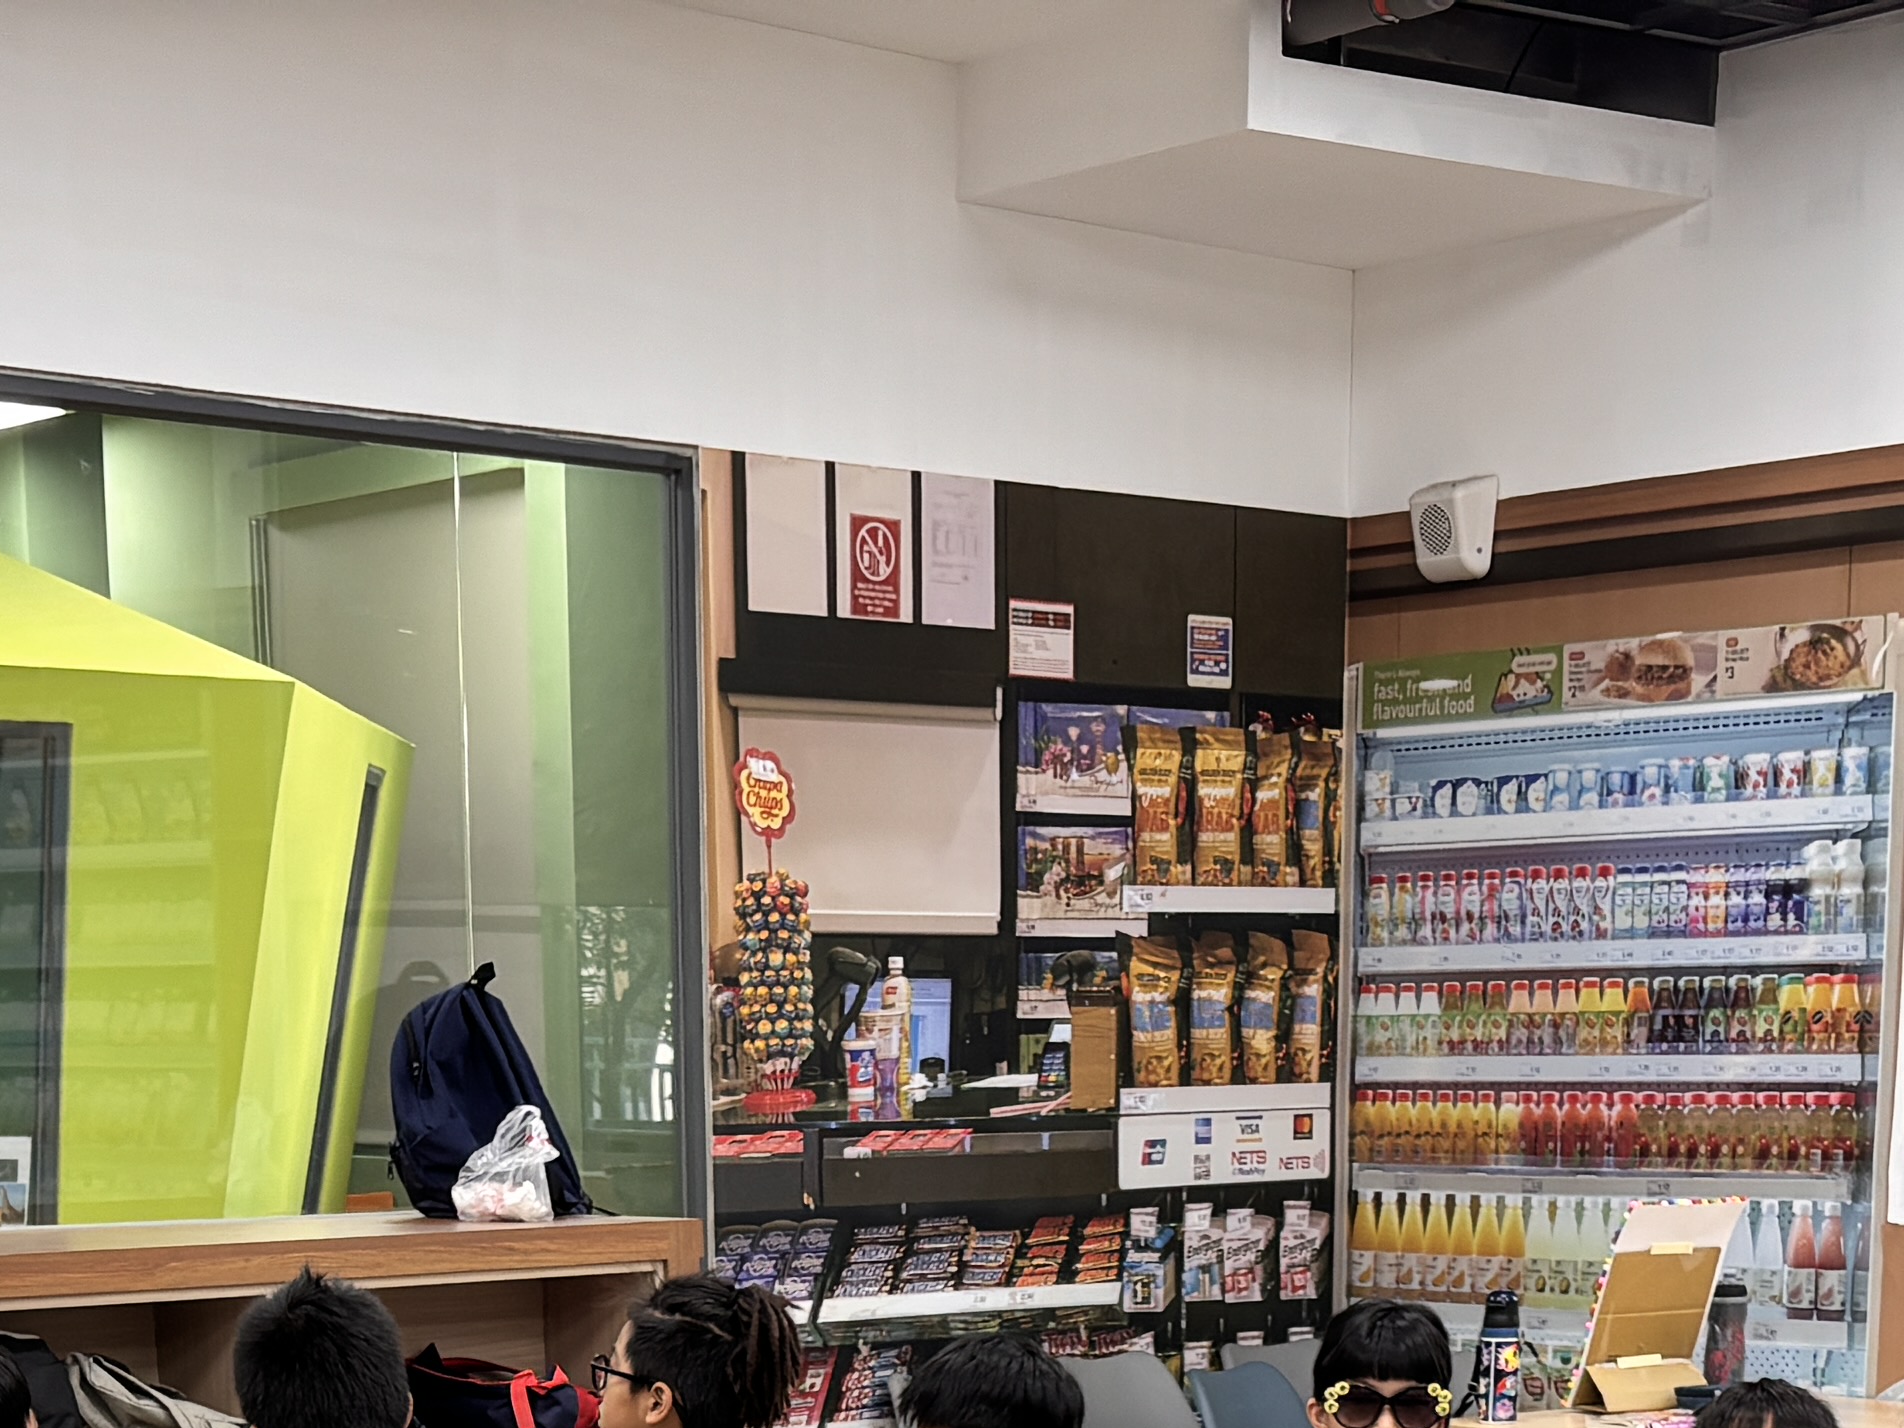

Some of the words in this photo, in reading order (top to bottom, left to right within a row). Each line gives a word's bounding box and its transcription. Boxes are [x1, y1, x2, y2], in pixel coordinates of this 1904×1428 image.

[1374, 683, 1403, 701] fast,
[1373, 698, 1440, 721] flavourful
[1444, 696, 1475, 714] food
[746, 790, 784, 811] Chups
[1240, 1123, 1260, 1135] VISA
[1231, 1150, 1267, 1166] NETS
[1279, 1156, 1311, 1170] NETS
